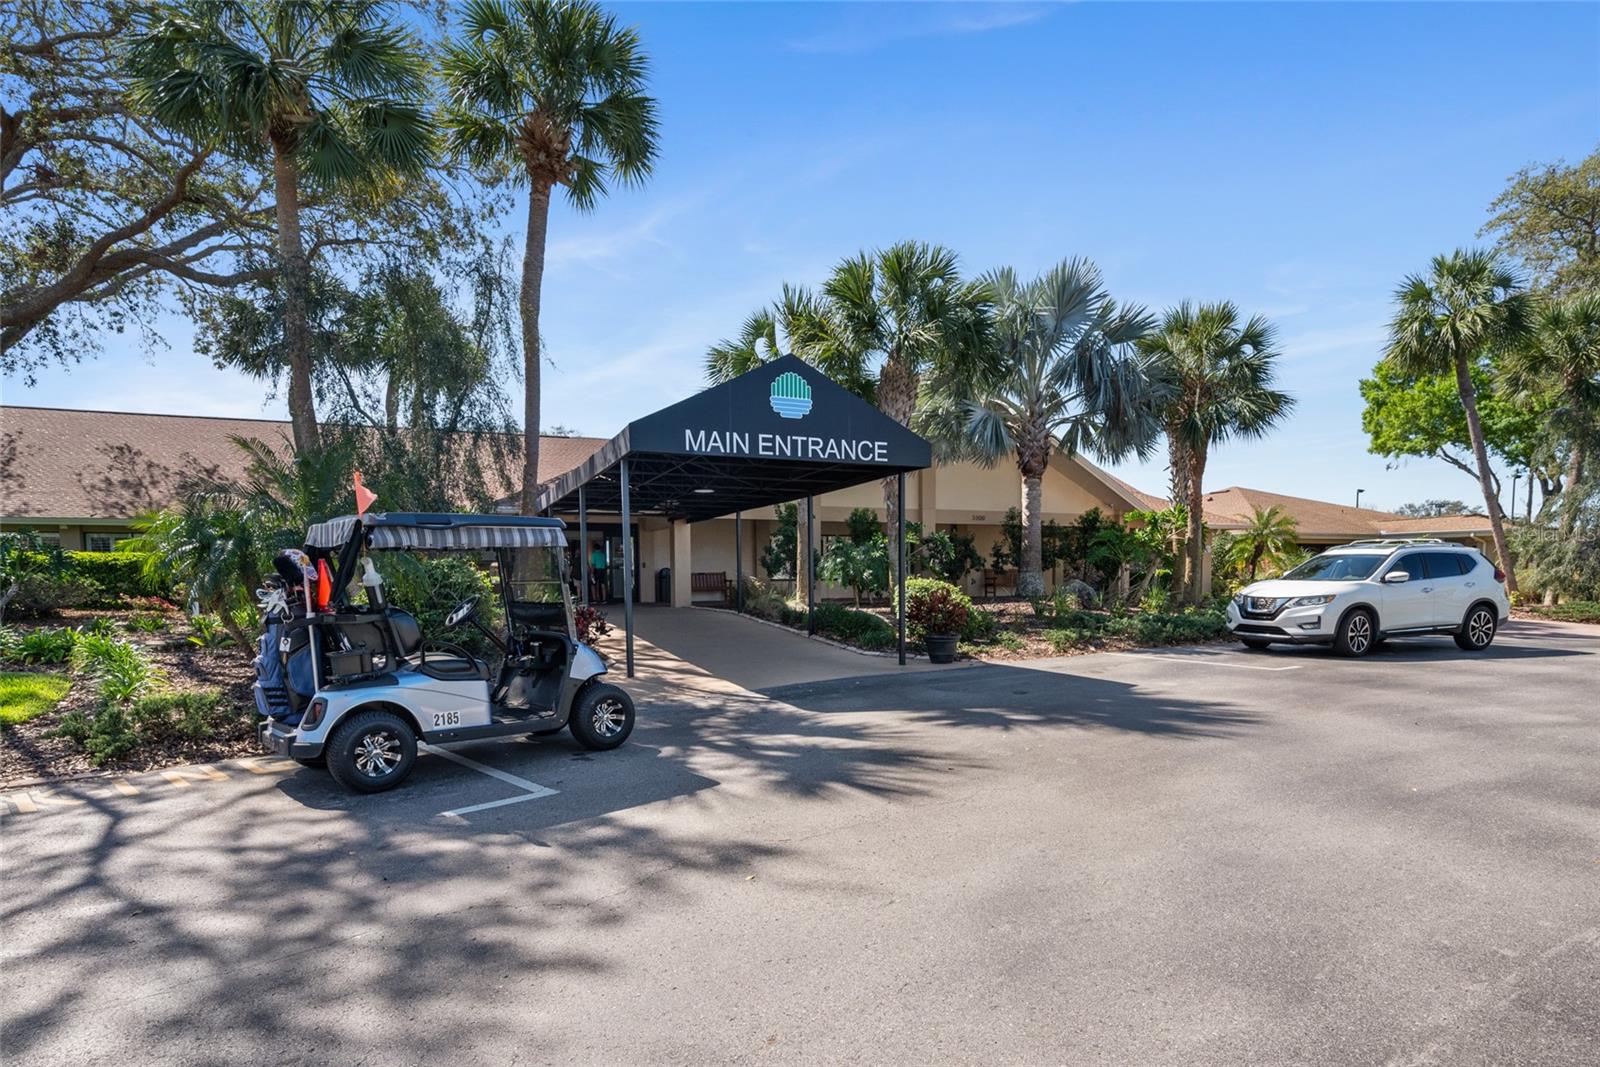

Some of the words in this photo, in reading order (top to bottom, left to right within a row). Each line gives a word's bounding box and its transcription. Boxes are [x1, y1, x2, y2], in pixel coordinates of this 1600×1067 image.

[685, 429, 749, 454] MAIN
[758, 434, 888, 462] ENTRANCE
[433, 711, 460, 727] 2185
